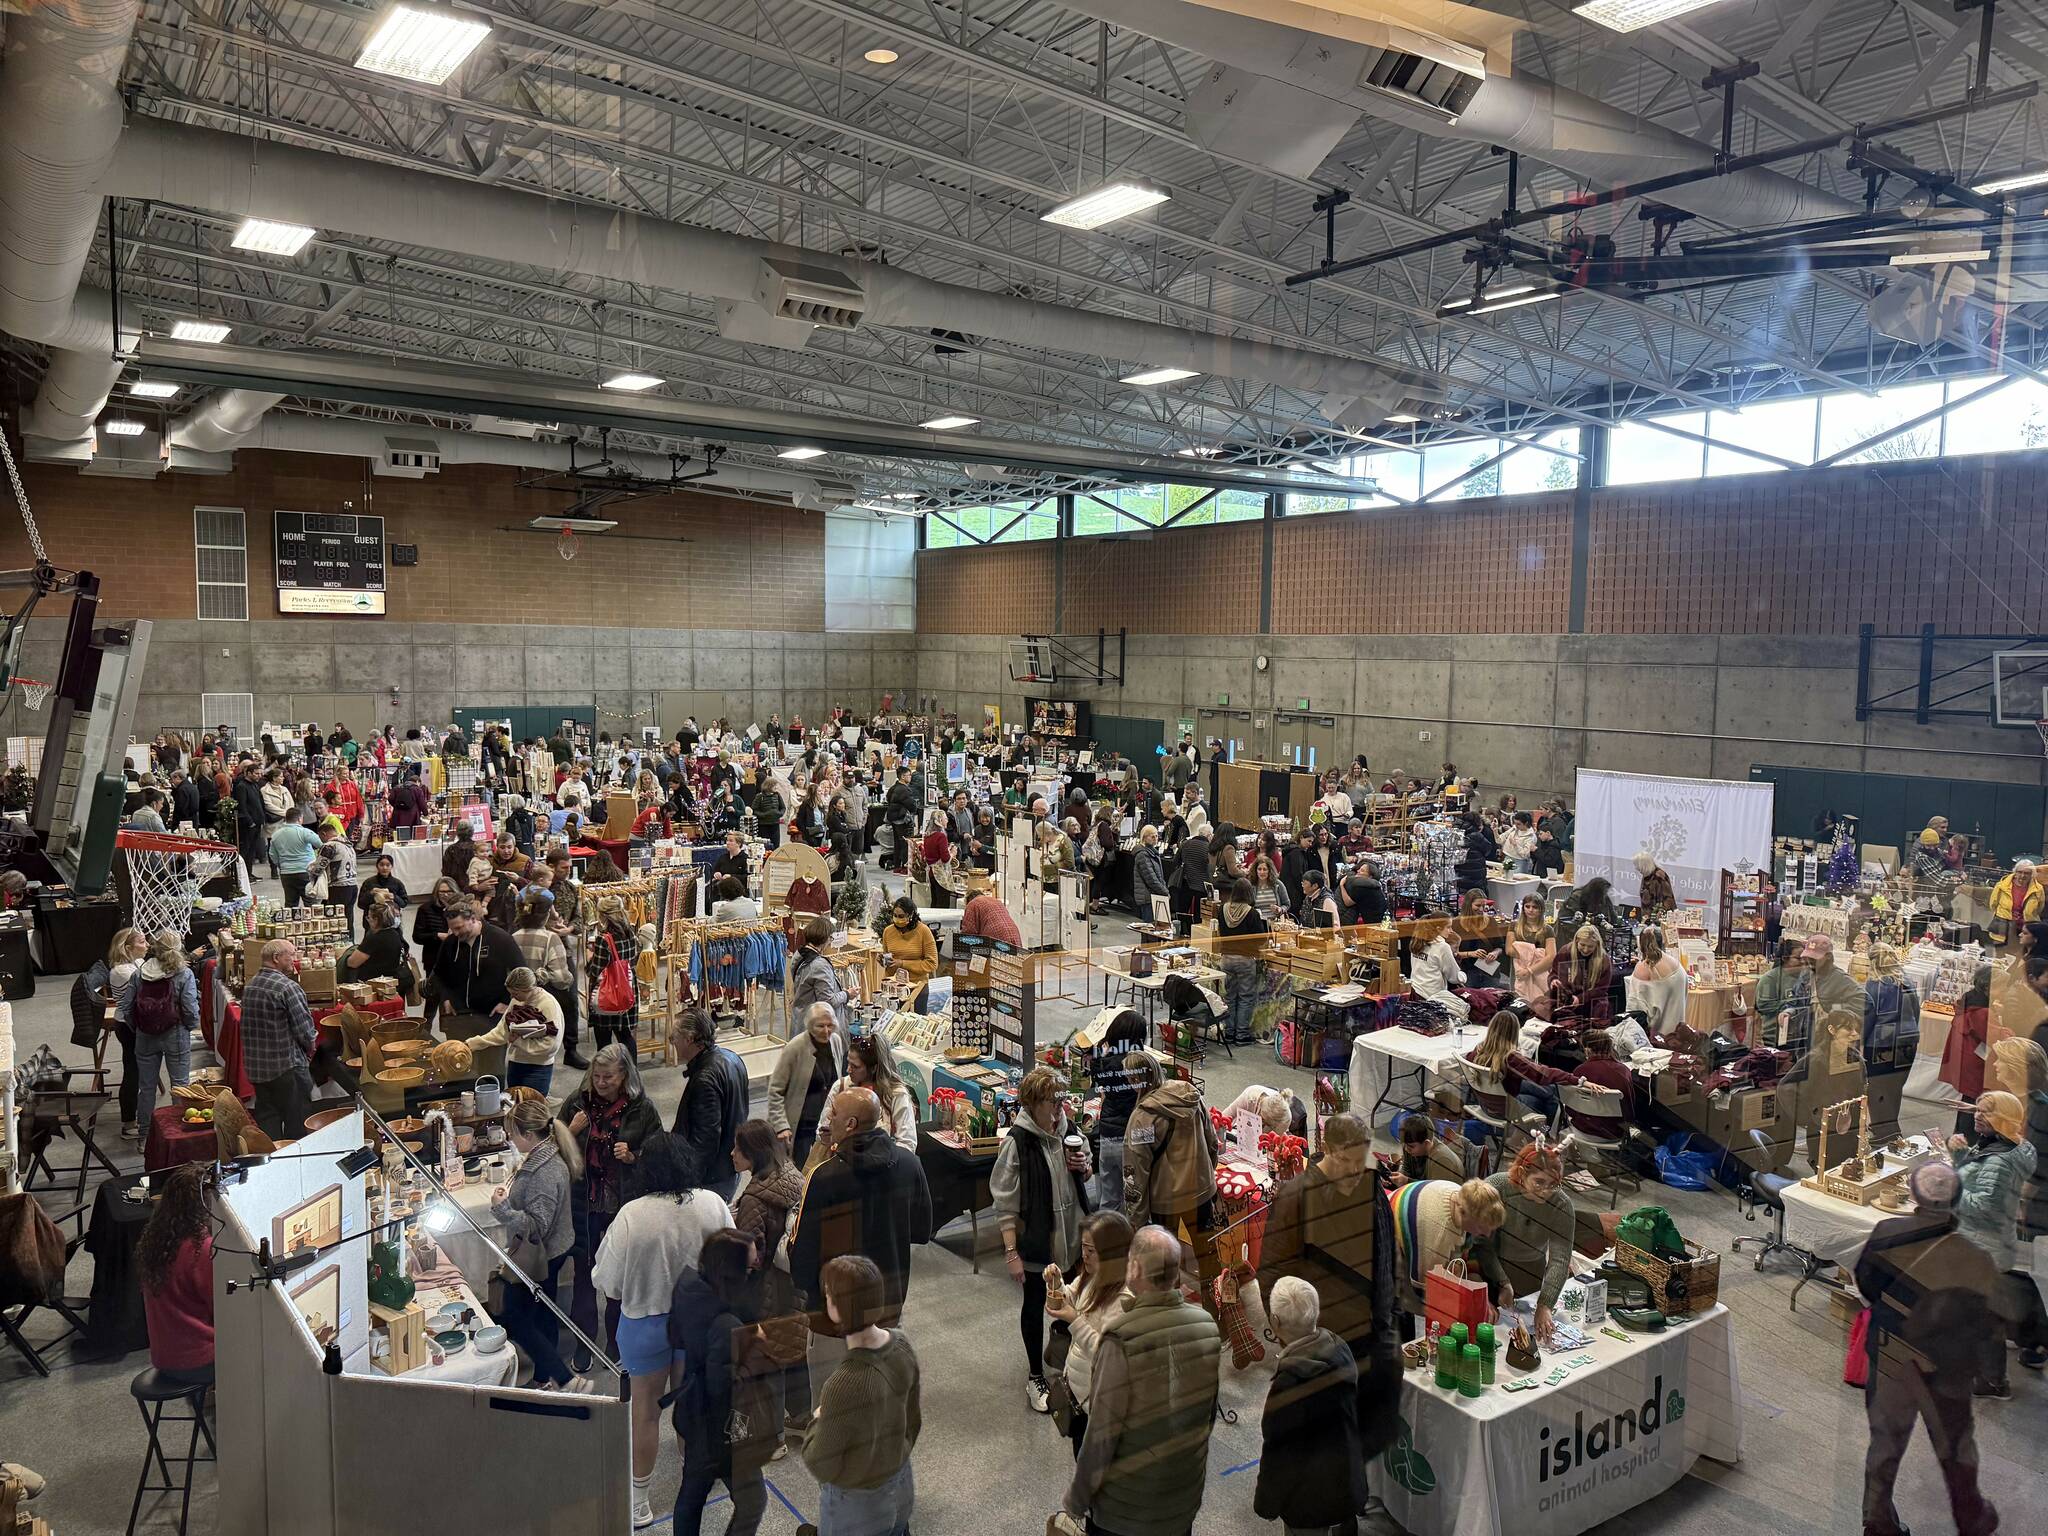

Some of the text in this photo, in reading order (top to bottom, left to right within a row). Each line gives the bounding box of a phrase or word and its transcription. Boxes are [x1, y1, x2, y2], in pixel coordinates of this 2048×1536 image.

[282, 532, 306, 541] HOME
[354, 536, 379, 545] GUEST
[1539, 1375, 1662, 1483] island
[1538, 1435, 1661, 1512] animal hospital
